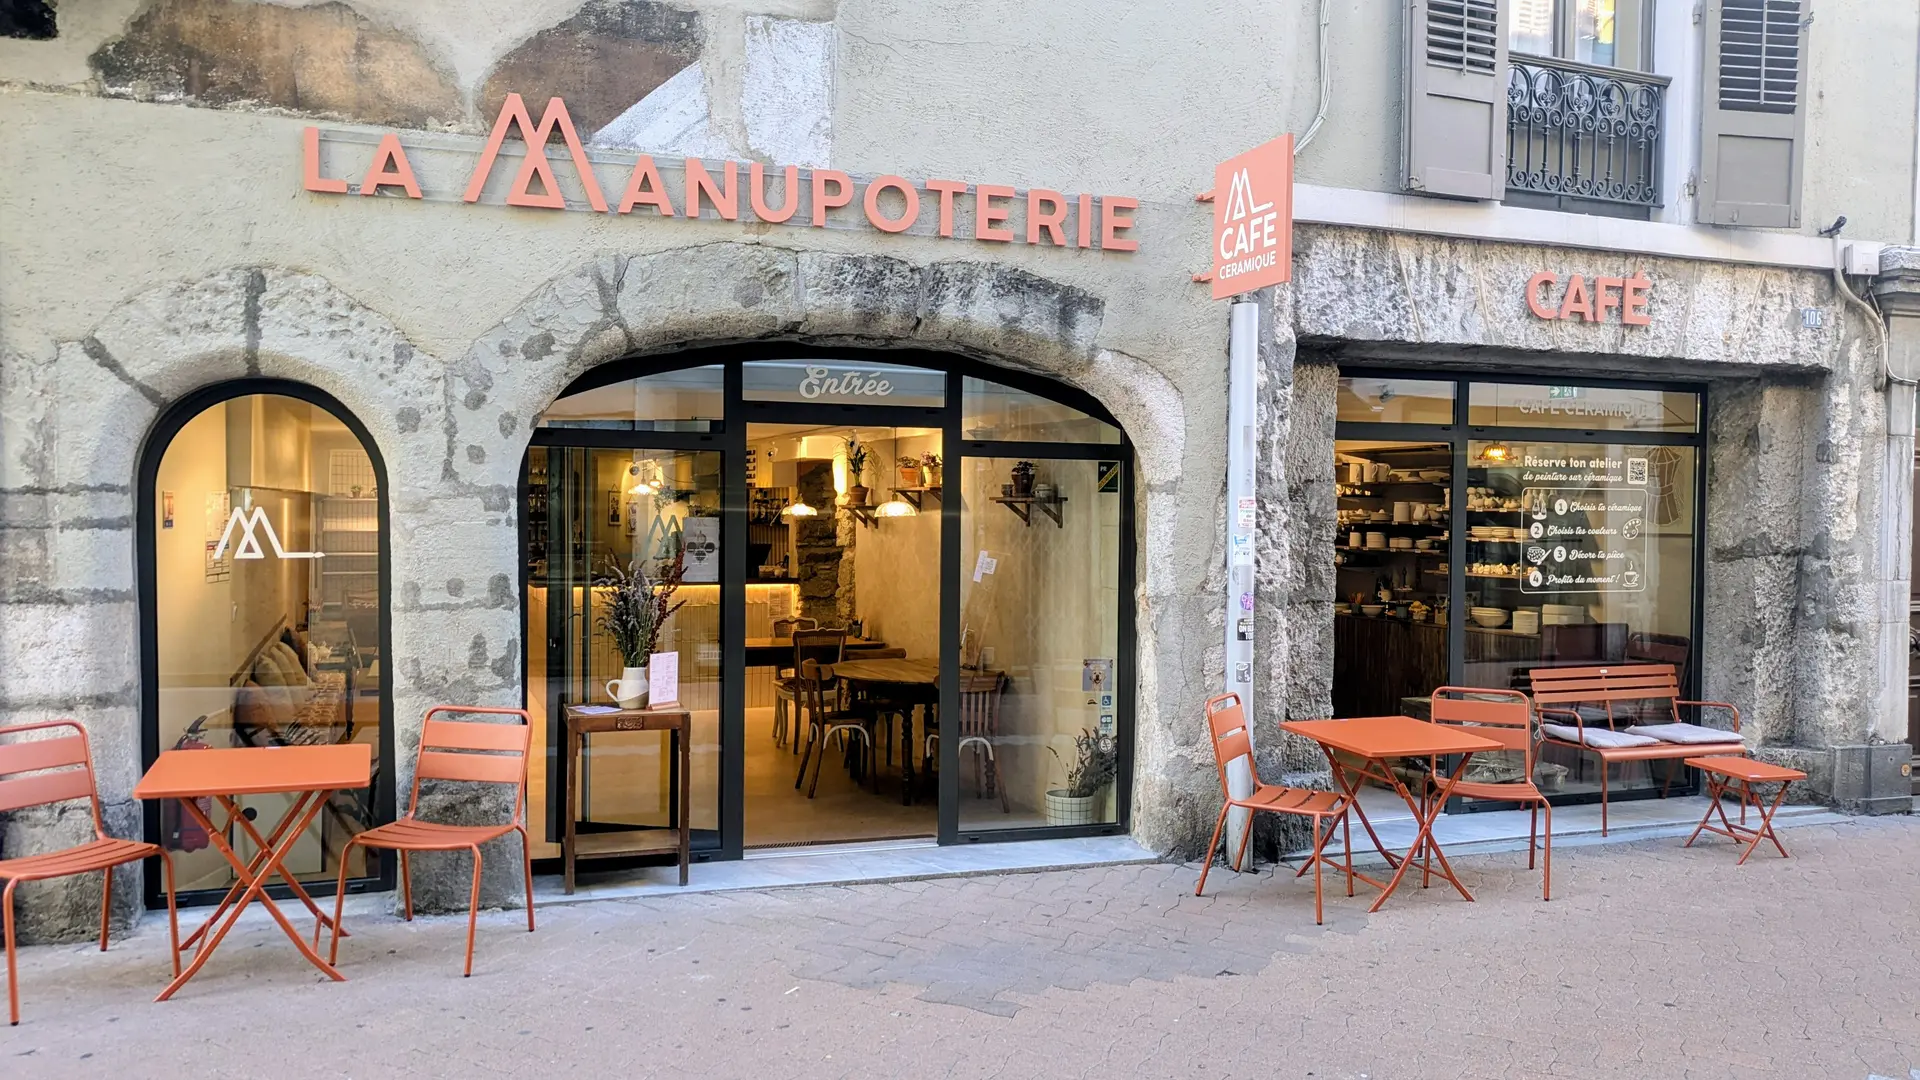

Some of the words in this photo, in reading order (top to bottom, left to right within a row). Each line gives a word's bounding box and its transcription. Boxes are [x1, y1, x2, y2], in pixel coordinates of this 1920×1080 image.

[304, 126, 423, 199] LA
[1220, 211, 1277, 260] CAFE
[1219, 250, 1277, 280] CERAMIQUE
[1526, 263, 1652, 326] CAFÉ
[1805, 310, 1822, 326] 106
[799, 363, 894, 399] Entrée
[1524, 455, 1567, 468] Réserve
[1570, 457, 1586, 468] ton
[1589, 457, 1623, 469] atelier
[1522, 470, 1534, 481] de
[1534, 472, 1568, 483] peinture
[1583, 472, 1624, 483] céramique
[1569, 501, 1597, 513] Choisis
[1597, 503, 1607, 512] ta
[1607, 503, 1643, 513] céramique
[1547, 525, 1574, 537] Choisis
[1574, 526, 1586, 535] tes
[1587, 526, 1618, 535] couleurs
[1568, 549, 1596, 561] Décore
[1596, 550, 1605, 559] ta
[1605, 550, 1625, 561] pièce
[1546, 574, 1575, 586] Profite
[1575, 574, 1586, 584] du
